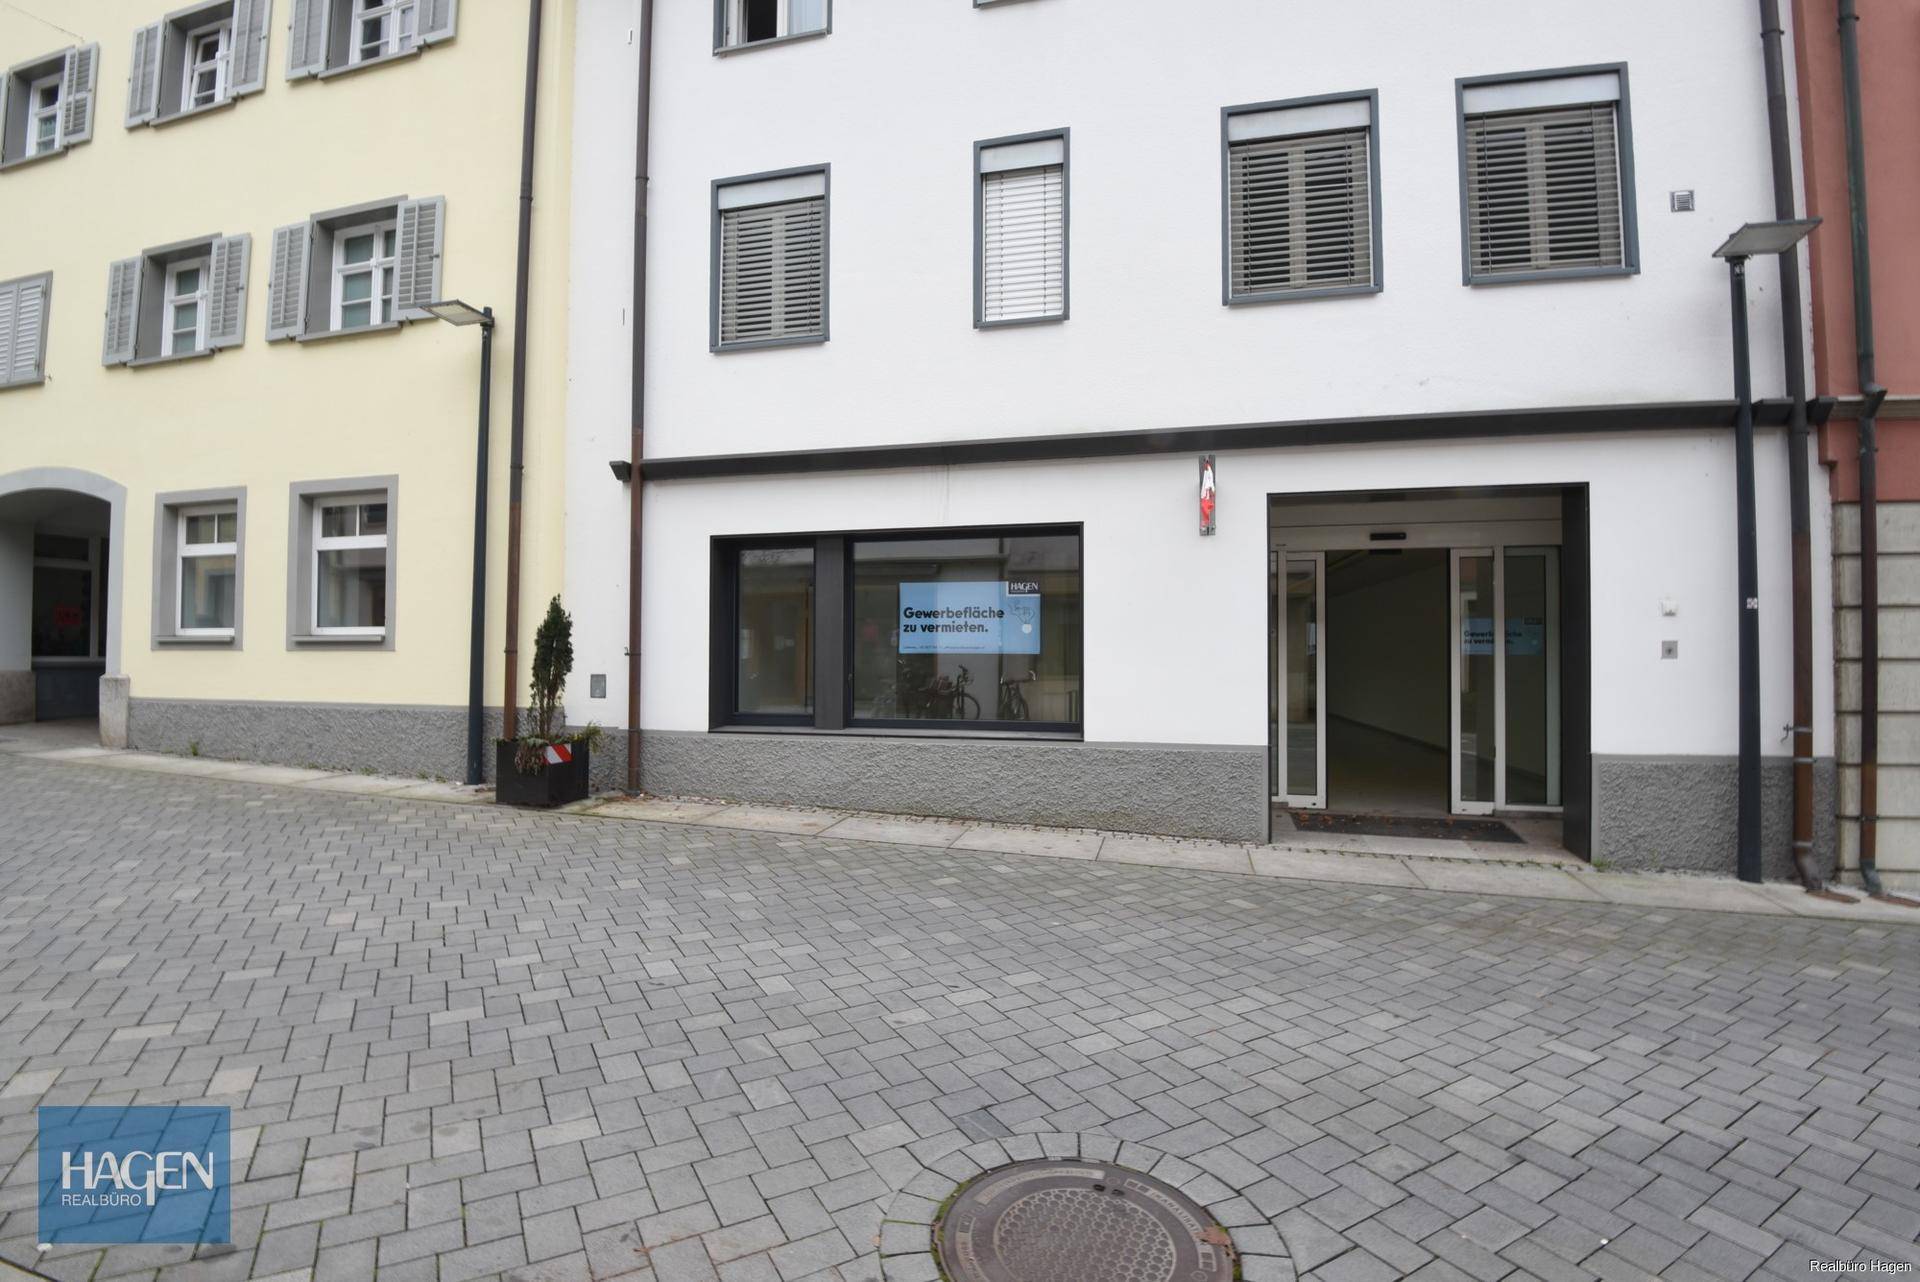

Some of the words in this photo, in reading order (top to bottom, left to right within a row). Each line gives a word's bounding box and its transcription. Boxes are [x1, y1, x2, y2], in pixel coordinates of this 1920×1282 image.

[1010, 582, 1039, 593] HAGEN
[903, 606, 1005, 619] Gewerbefläche
[903, 624, 917, 633] zu
[921, 621, 989, 633] vermieten.
